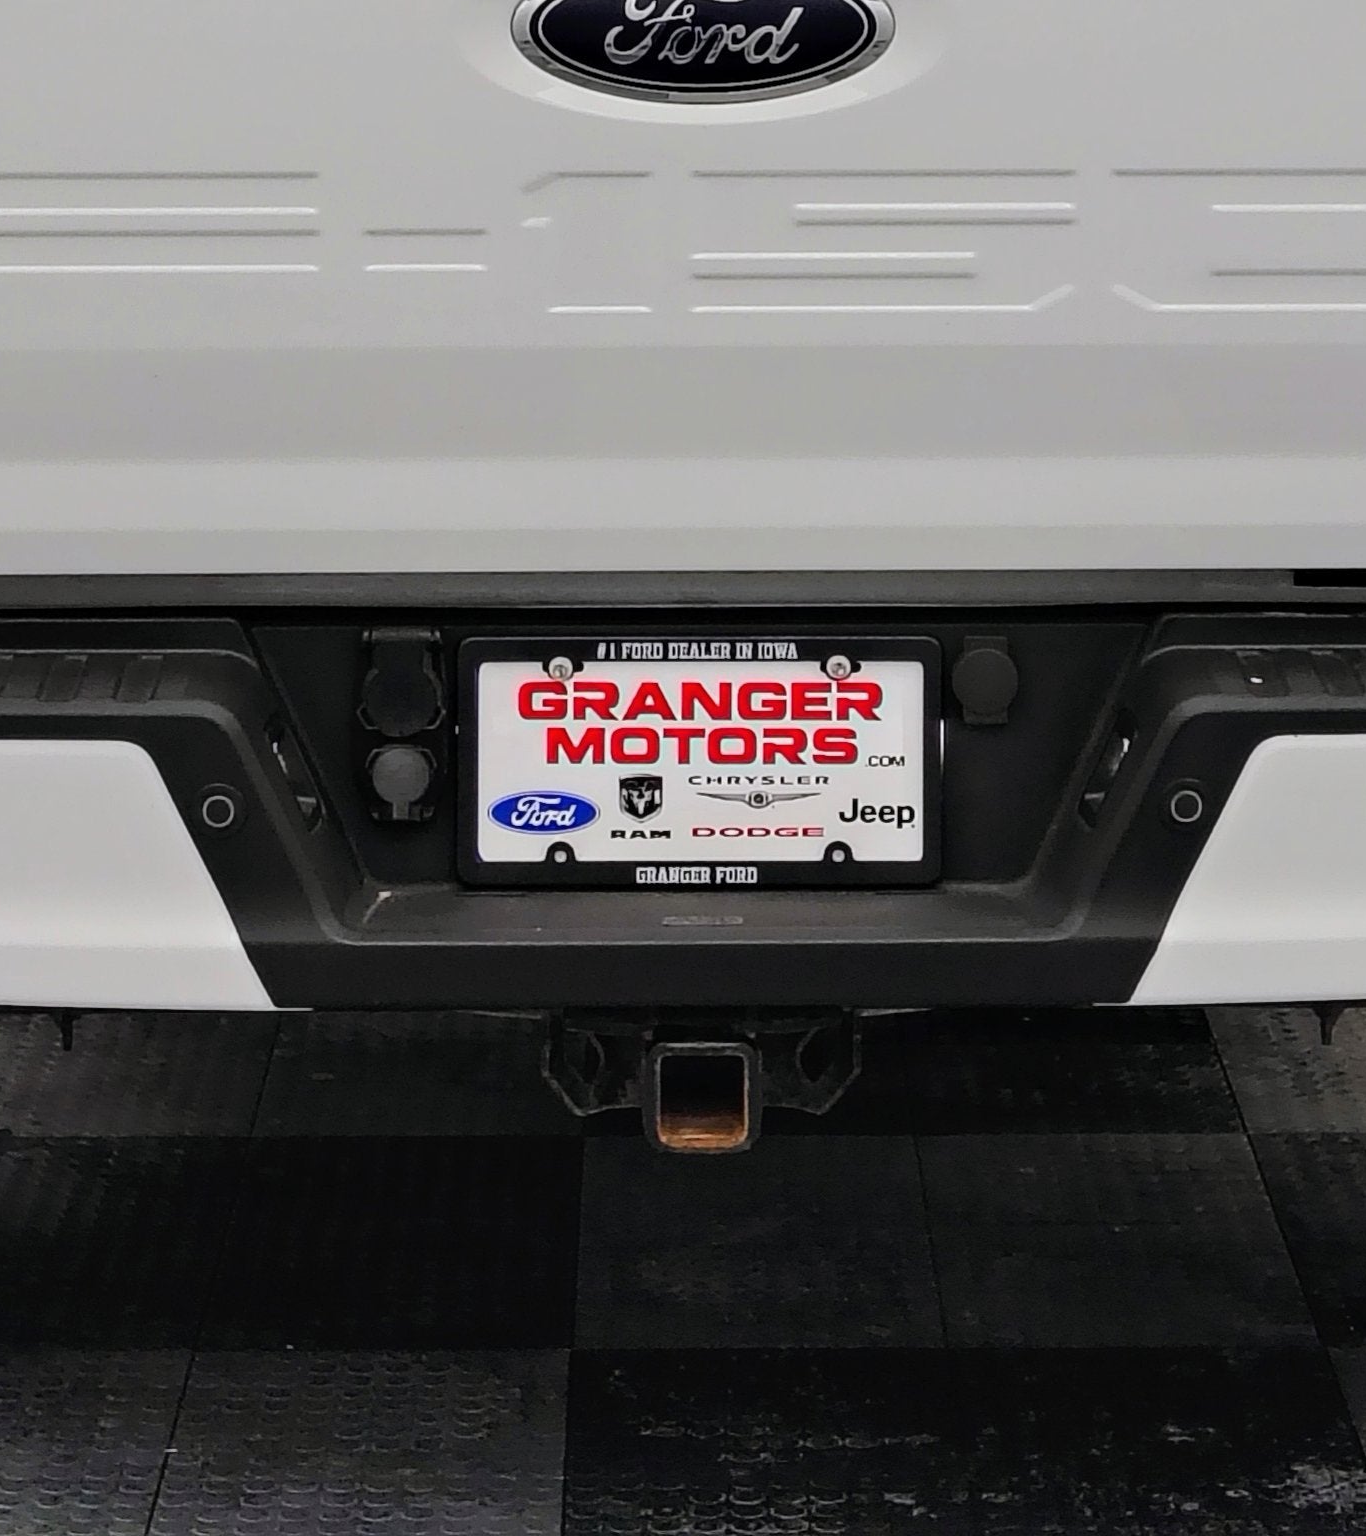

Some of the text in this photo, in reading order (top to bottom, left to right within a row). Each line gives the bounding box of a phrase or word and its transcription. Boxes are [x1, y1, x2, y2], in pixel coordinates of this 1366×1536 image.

[621, 642, 664, 660] FORD
[667, 642, 731, 660] DEALER
[735, 642, 754, 660] IN
[757, 642, 799, 660] IOWA
[518, 681, 883, 721] GRANGER
[546, 727, 858, 765] MOTORS
[688, 775, 830, 785] CHRYSLER
[511, 796, 576, 828] Ford
[839, 799, 915, 828] Jeep
[610, 830, 671, 839] RAM
[692, 827, 824, 837] DODGE
[636, 866, 758, 884] GRANGER FORD
